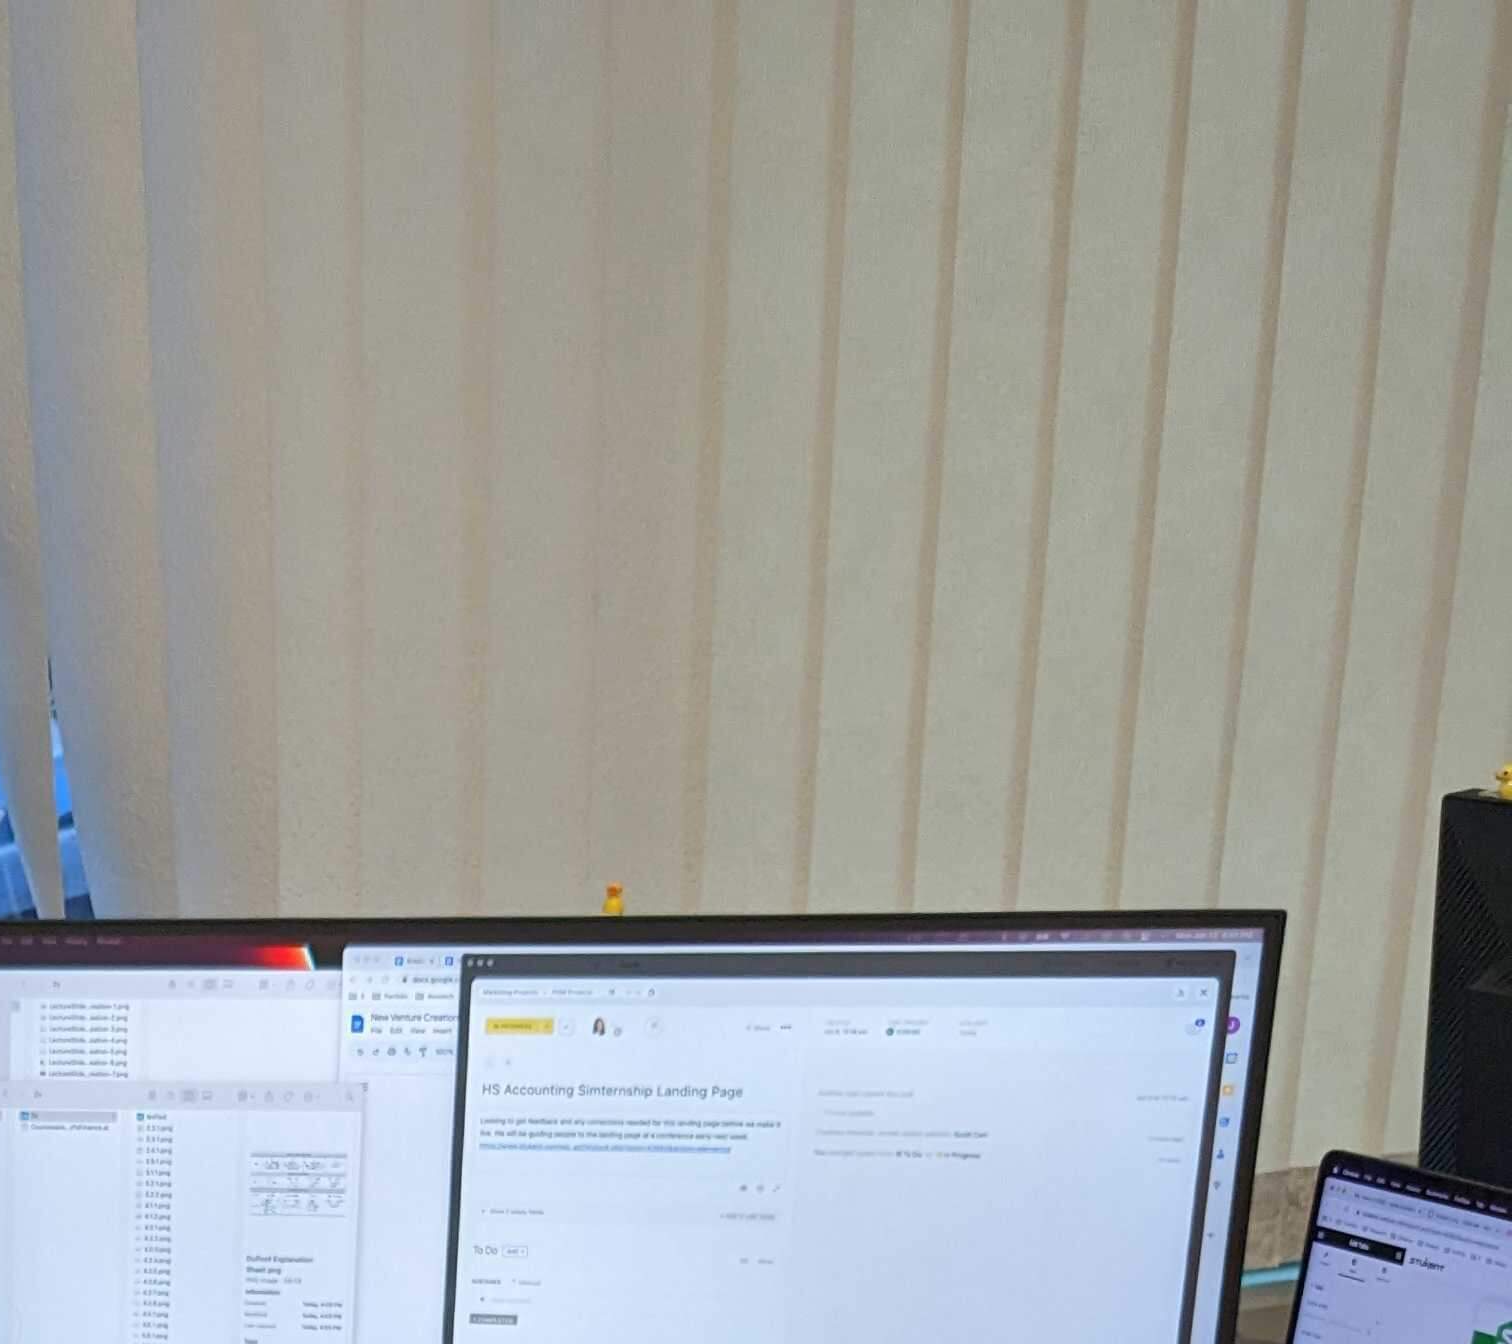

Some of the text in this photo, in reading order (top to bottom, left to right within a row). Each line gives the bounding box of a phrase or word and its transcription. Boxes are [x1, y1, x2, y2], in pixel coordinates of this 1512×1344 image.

[370, 1013, 389, 1022] New
[390, 1013, 421, 1022] Venture
[481, 1083, 744, 1100] HS Accounting Simternship Landing Page
[473, 1245, 498, 1256] To Do
